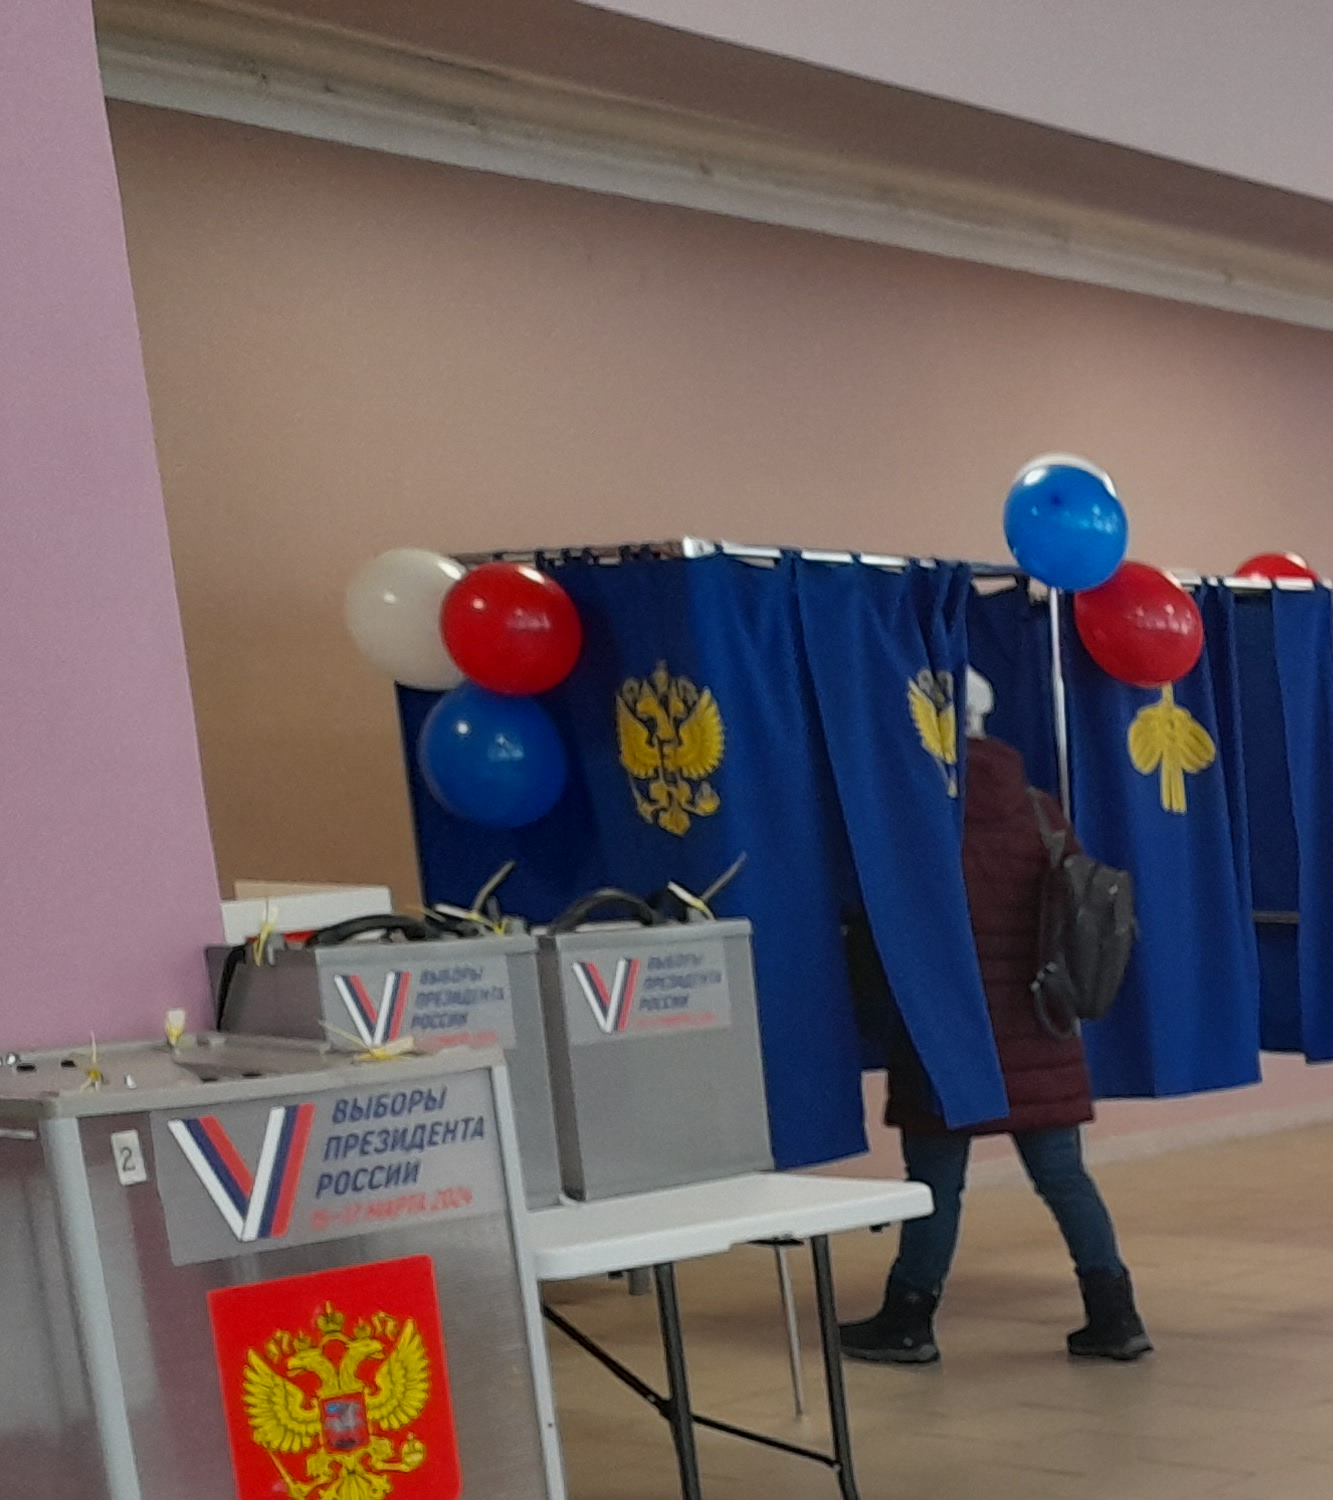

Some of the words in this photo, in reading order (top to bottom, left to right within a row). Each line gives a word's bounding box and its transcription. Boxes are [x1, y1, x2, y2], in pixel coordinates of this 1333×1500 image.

[331, 1086, 448, 1125] ВЫБОРЫ
[322, 1115, 485, 1162] ПРЕЗИДЕНТА
[119, 1146, 137, 1173] 2
[315, 1160, 421, 1199] РОССИИ
